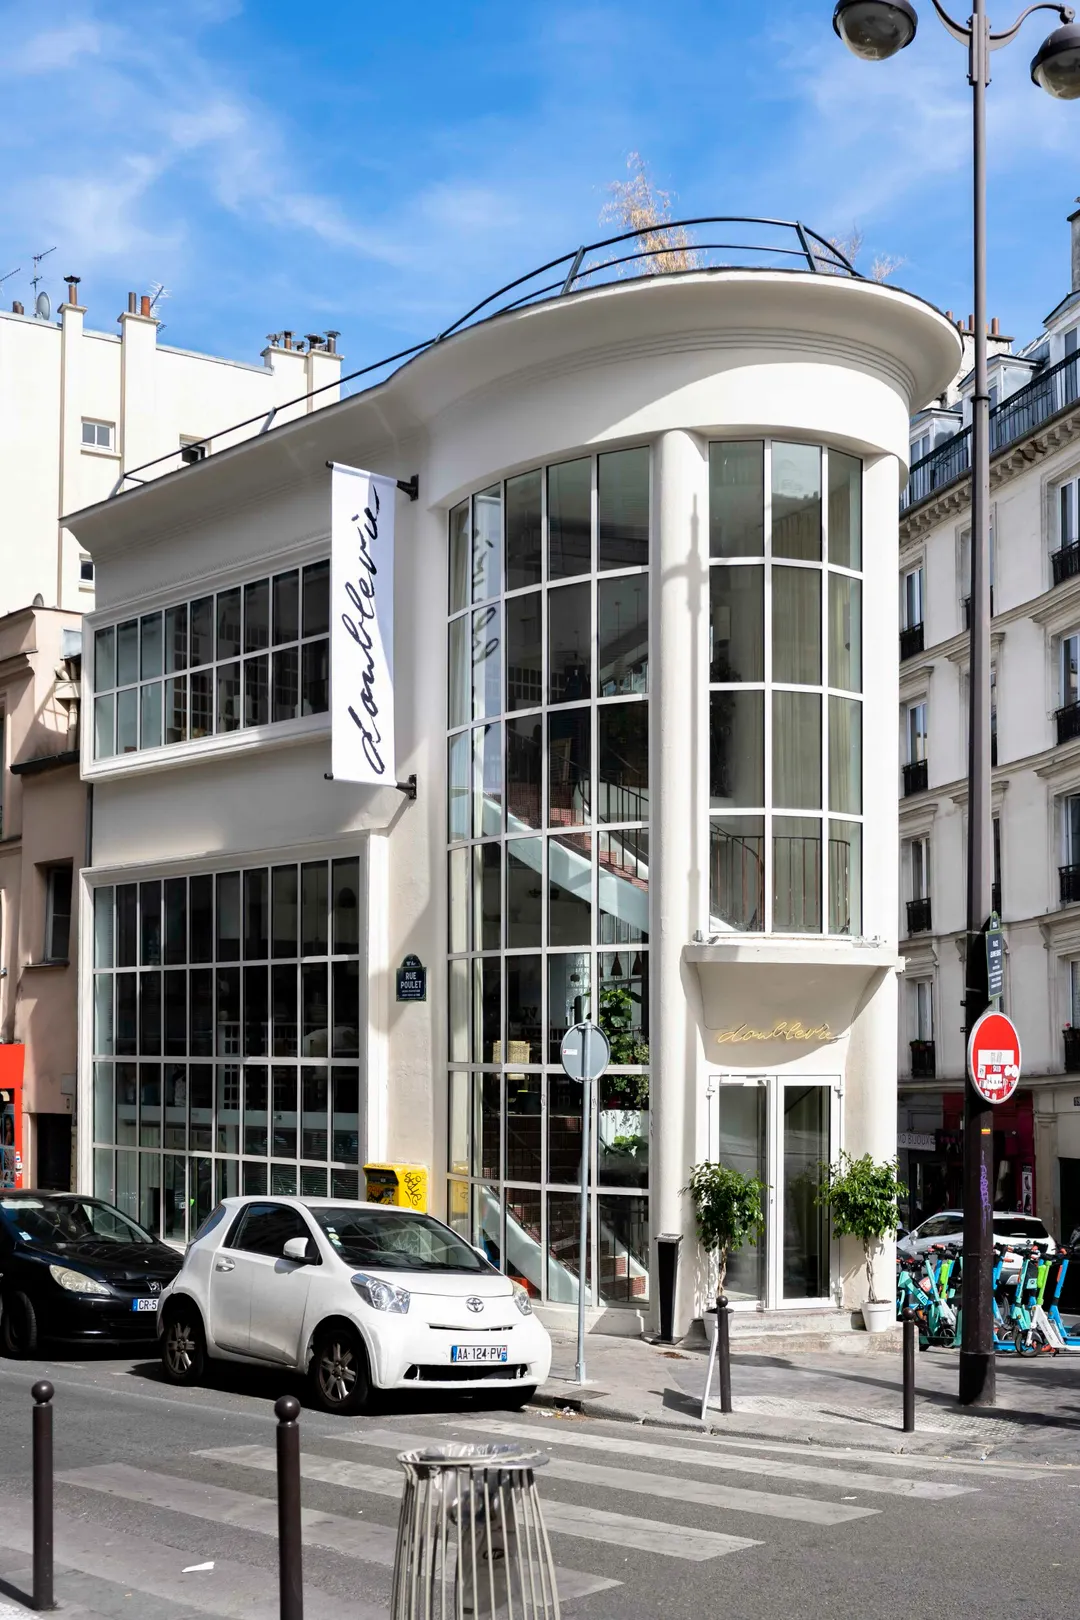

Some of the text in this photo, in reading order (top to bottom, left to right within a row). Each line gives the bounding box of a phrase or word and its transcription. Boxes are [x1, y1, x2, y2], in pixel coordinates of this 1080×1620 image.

[341, 484, 385, 775] doublevie
[405, 971, 417, 980] RUE
[400, 980, 422, 989] POULET
[908, 1134, 930, 1145] BIJOUX
[457, 1347, 502, 1360] AA-124-PV
